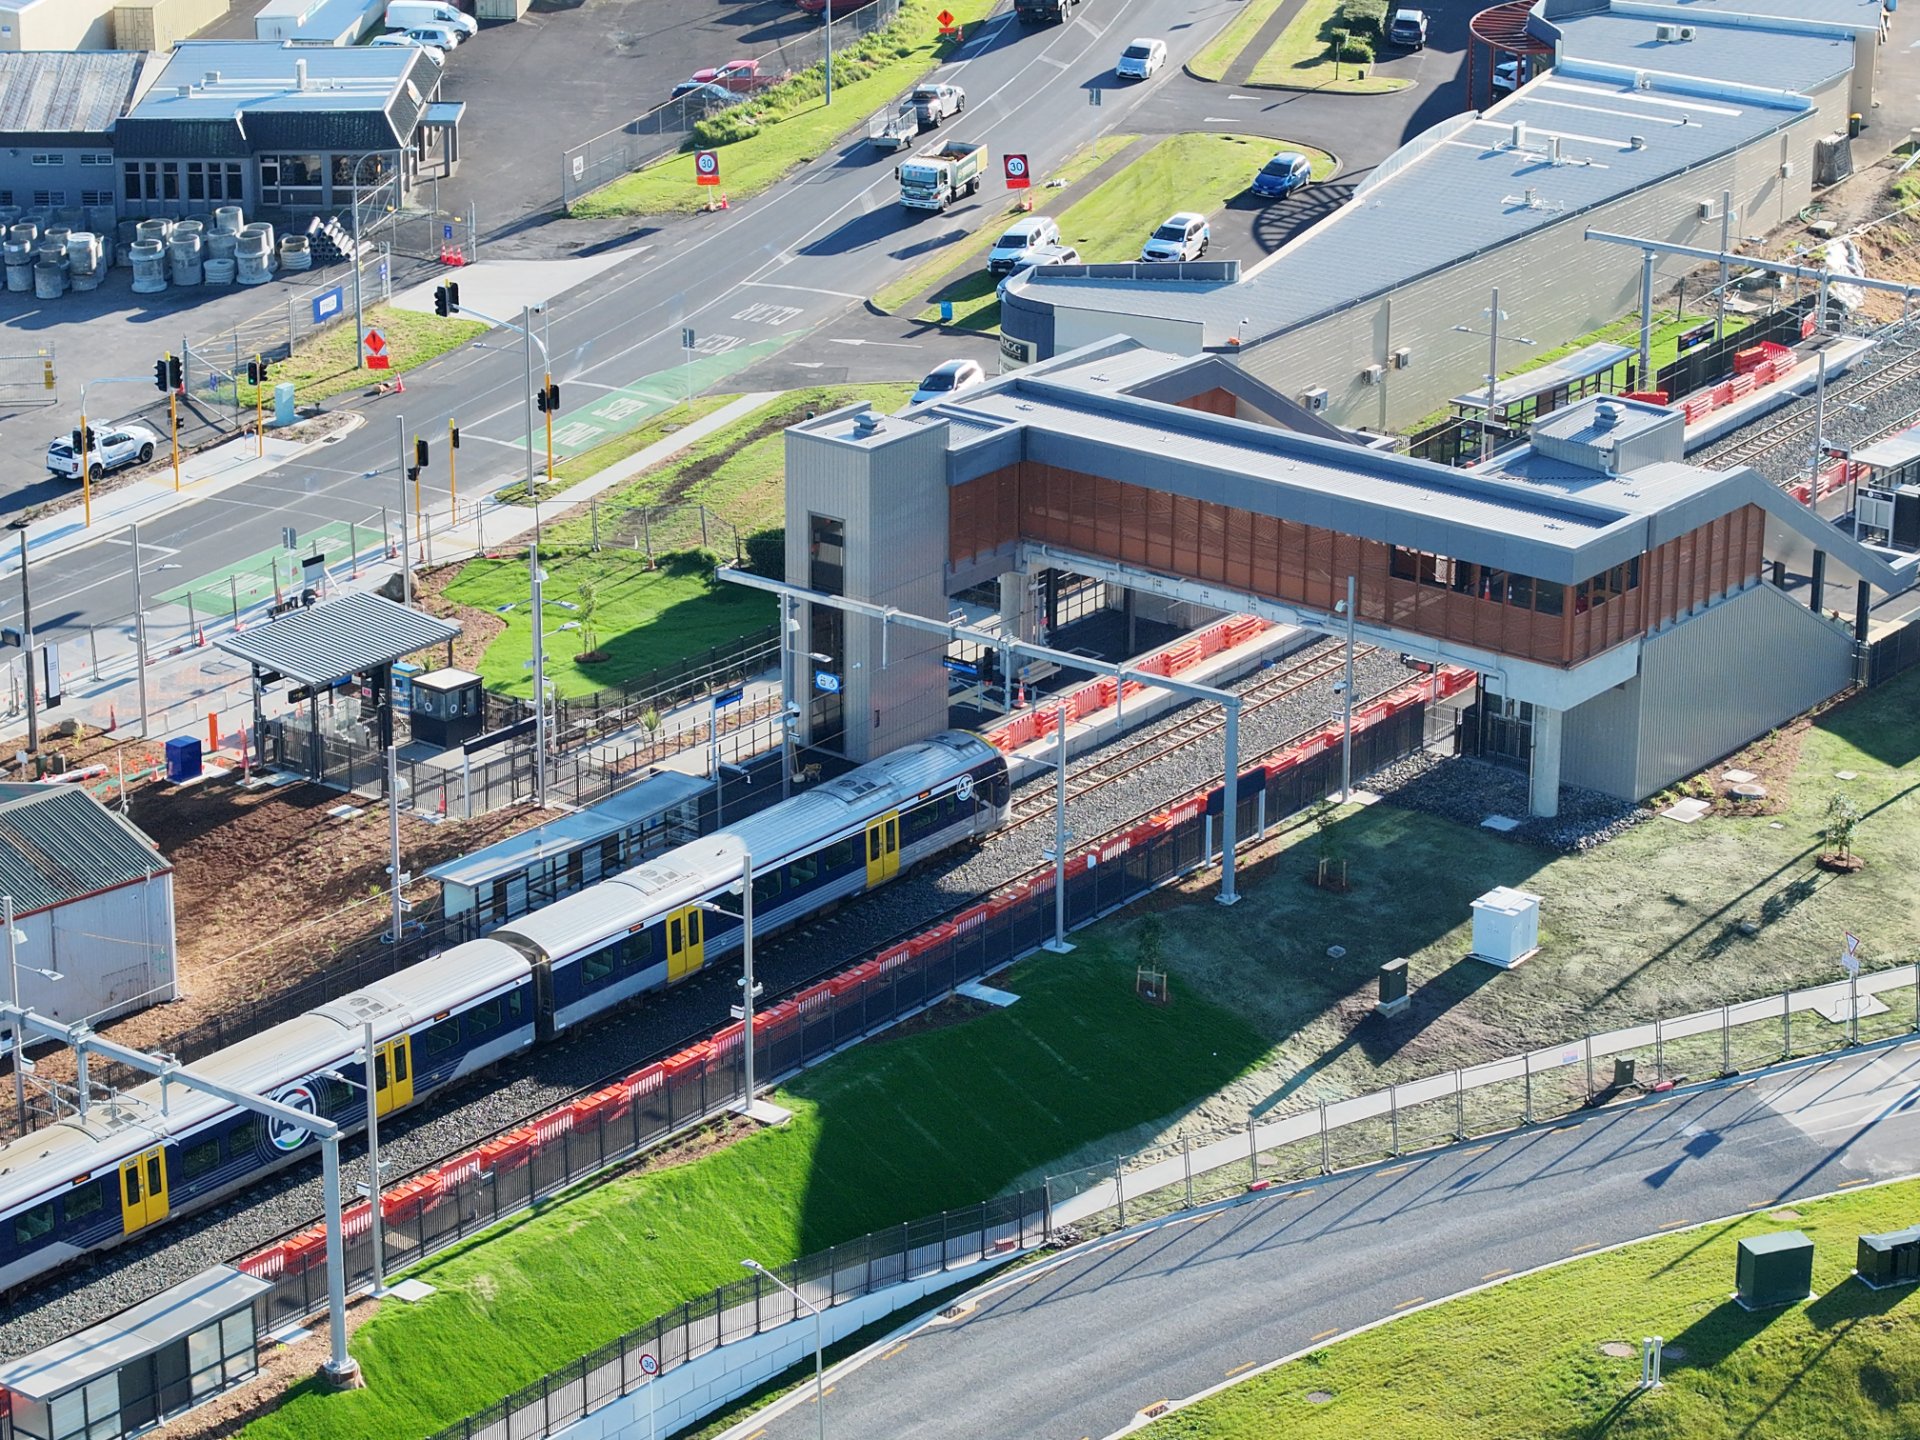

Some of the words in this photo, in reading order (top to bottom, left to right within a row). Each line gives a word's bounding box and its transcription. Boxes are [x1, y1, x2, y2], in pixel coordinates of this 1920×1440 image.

[701, 158, 713, 169] 30
[1010, 162, 1023, 172] 30
[731, 303, 804, 325] CLEAR
[693, 333, 746, 354] KEEP
[591, 398, 648, 421] BUS
[644, 1359, 654, 1370] 30
